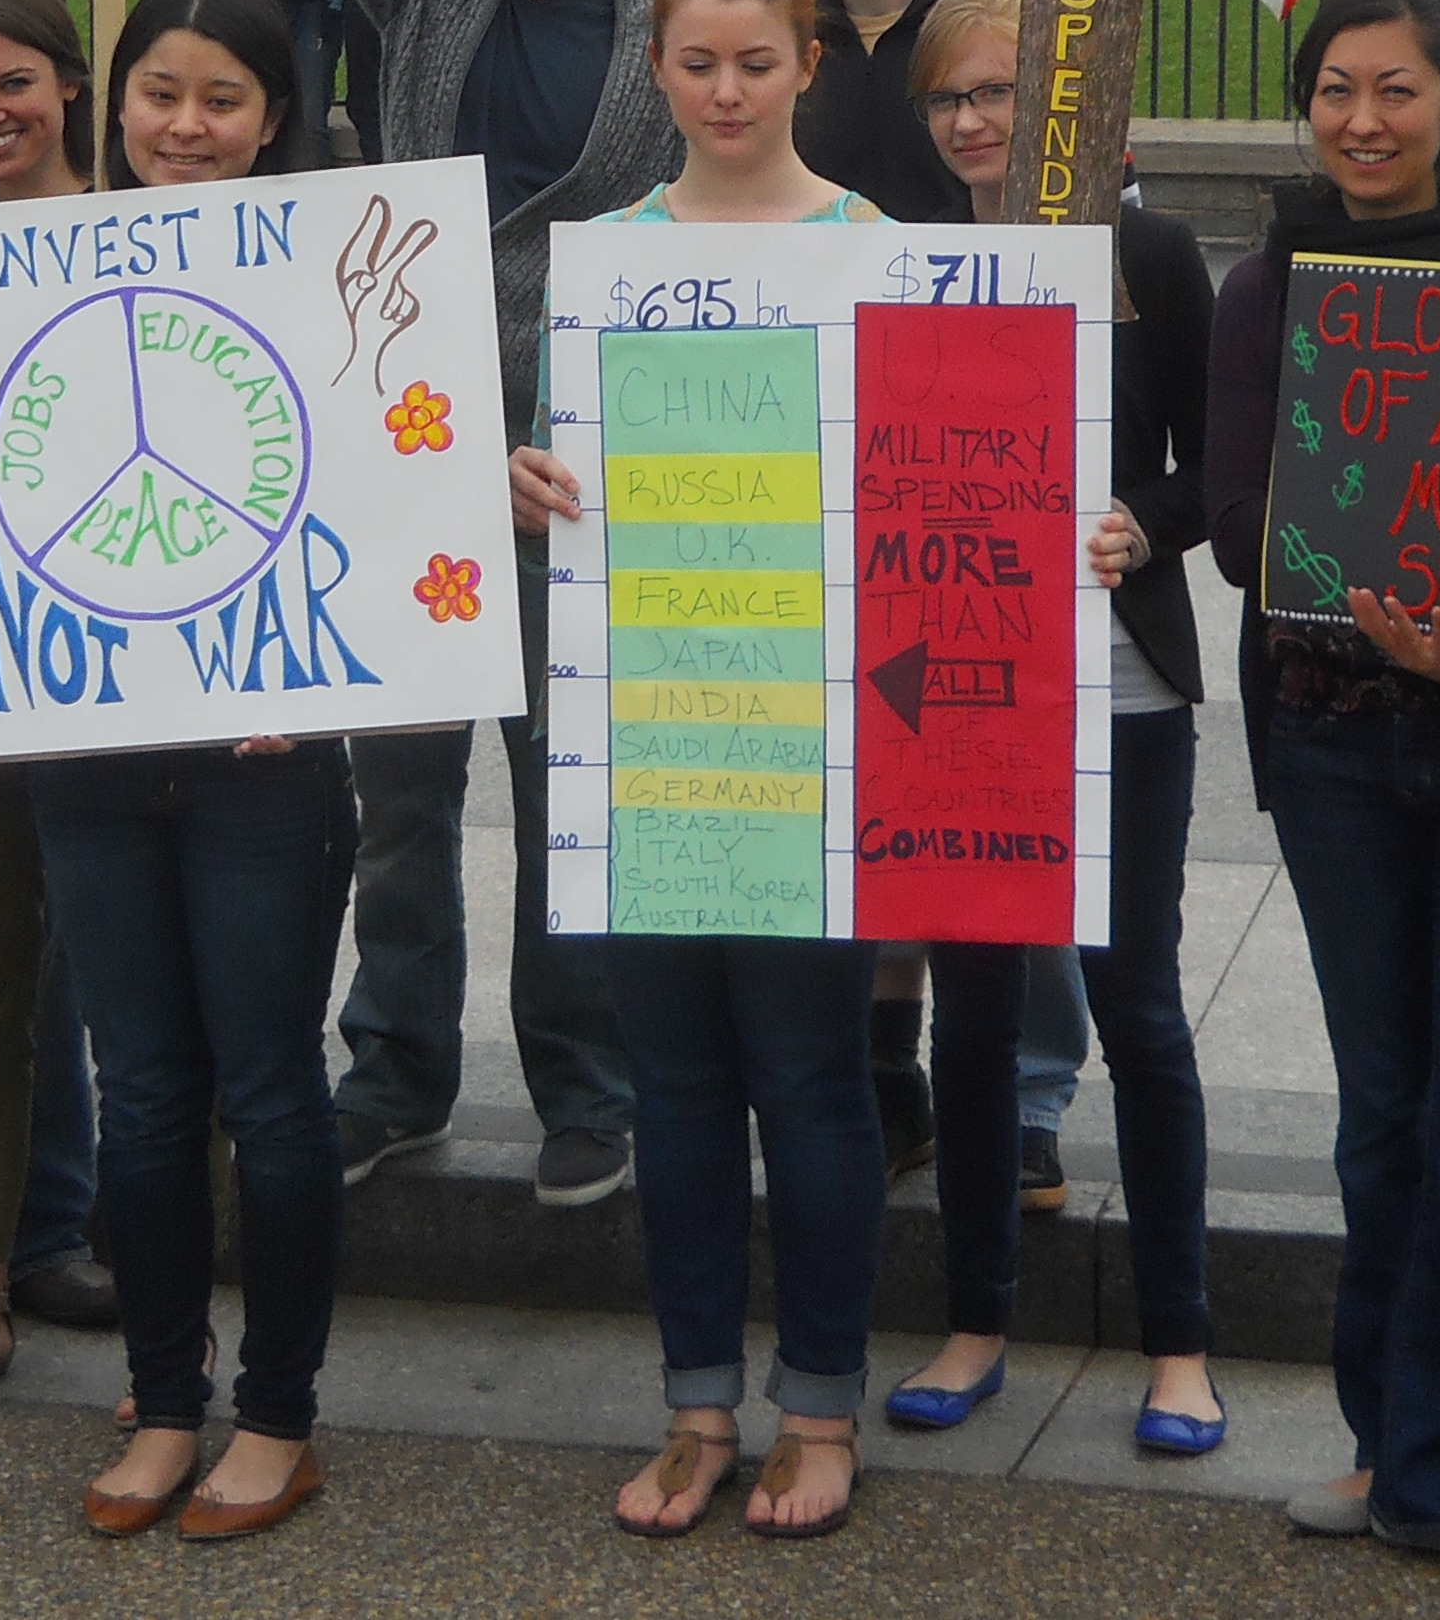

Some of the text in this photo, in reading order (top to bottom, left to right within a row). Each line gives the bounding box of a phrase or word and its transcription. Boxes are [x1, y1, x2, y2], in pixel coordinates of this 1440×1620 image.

[234, 200, 299, 268] IN
[882, 246, 1059, 306] $711 bn
[606, 274, 793, 332] $695 bn
[137, 310, 296, 524] EDUCATION
[617, 365, 786, 429] CHINA
[1338, 367, 1429, 444] OF
[2, 360, 67, 491] JOBS
[863, 424, 1051, 475] MILITARY
[627, 467, 777, 508] RUSSIA
[859, 476, 1071, 517] SPENDING
[67, 469, 232, 568] PEACE
[675, 526, 773, 565] U.K.
[863, 529, 1033, 588] MORE
[175, 512, 385, 695] WAR
[634, 575, 808, 621] FRANCE
[865, 588, 1033, 644] THAN
[627, 632, 784, 677] JAPAN
[648, 685, 773, 723] INDIA
[923, 665, 1002, 697] ALL
[615, 725, 824, 768] SAUDI ARABIA
[624, 769, 806, 809] GERMANY
[635, 807, 775, 834] BRAZIL
[859, 816, 1070, 865] COMBINED
[634, 835, 745, 867] ITALY
[623, 866, 816, 904] SOUTH KOREA
[619, 896, 779, 931] AUSTRALIA
